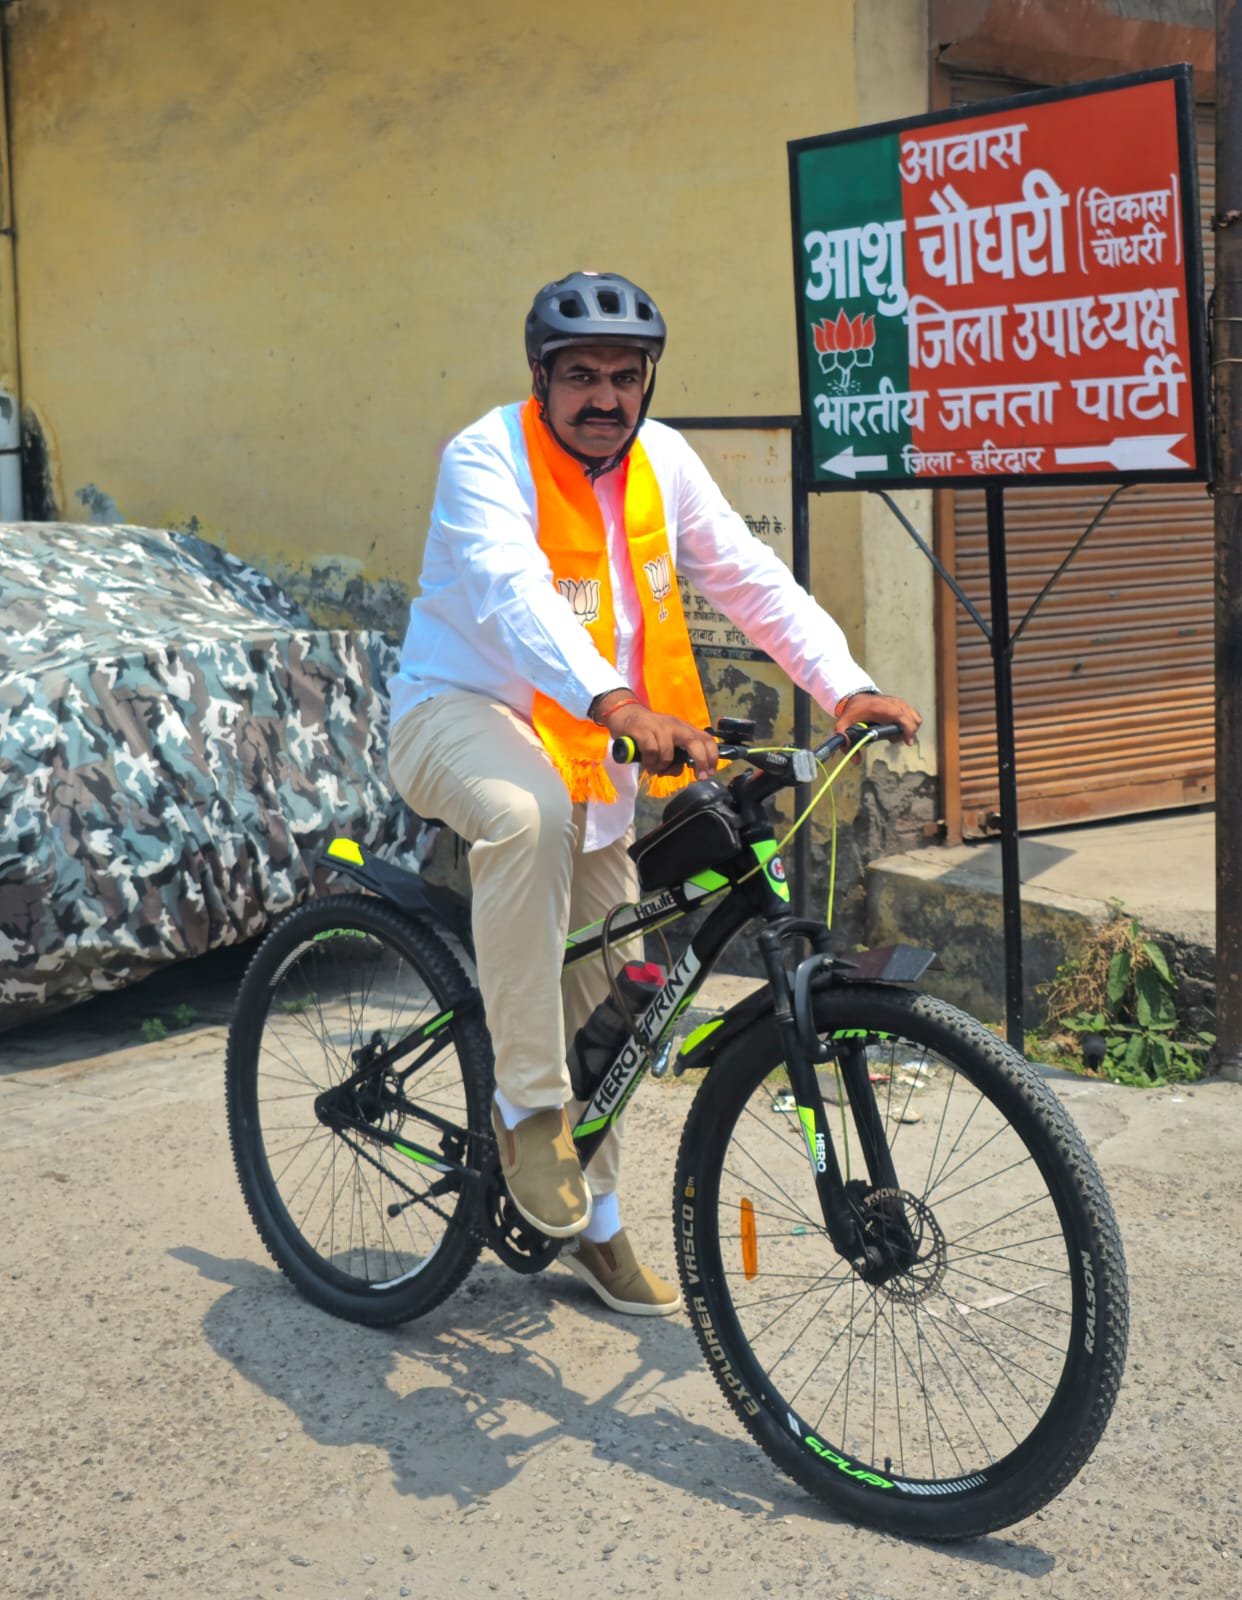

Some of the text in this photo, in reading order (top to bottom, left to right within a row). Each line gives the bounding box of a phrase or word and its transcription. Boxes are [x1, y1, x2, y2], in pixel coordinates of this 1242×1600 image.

[899, 123, 1029, 184] आवास
[804, 168, 1070, 318] आशु चौधरी
[902, 287, 1180, 369] जिला उपाध्यक्ष
[814, 354, 1187, 436] भारतीय जनता पार्टी
[967, 439, 1045, 473] हरिद्वार
[594, 957, 694, 1114] HERO SPRINT
[815, 1133, 826, 1173] HERO
[683, 1204, 700, 1285] VASCO
[1081, 1250, 1097, 1355] RALSON
[691, 1297, 761, 1417] EXPLORER
